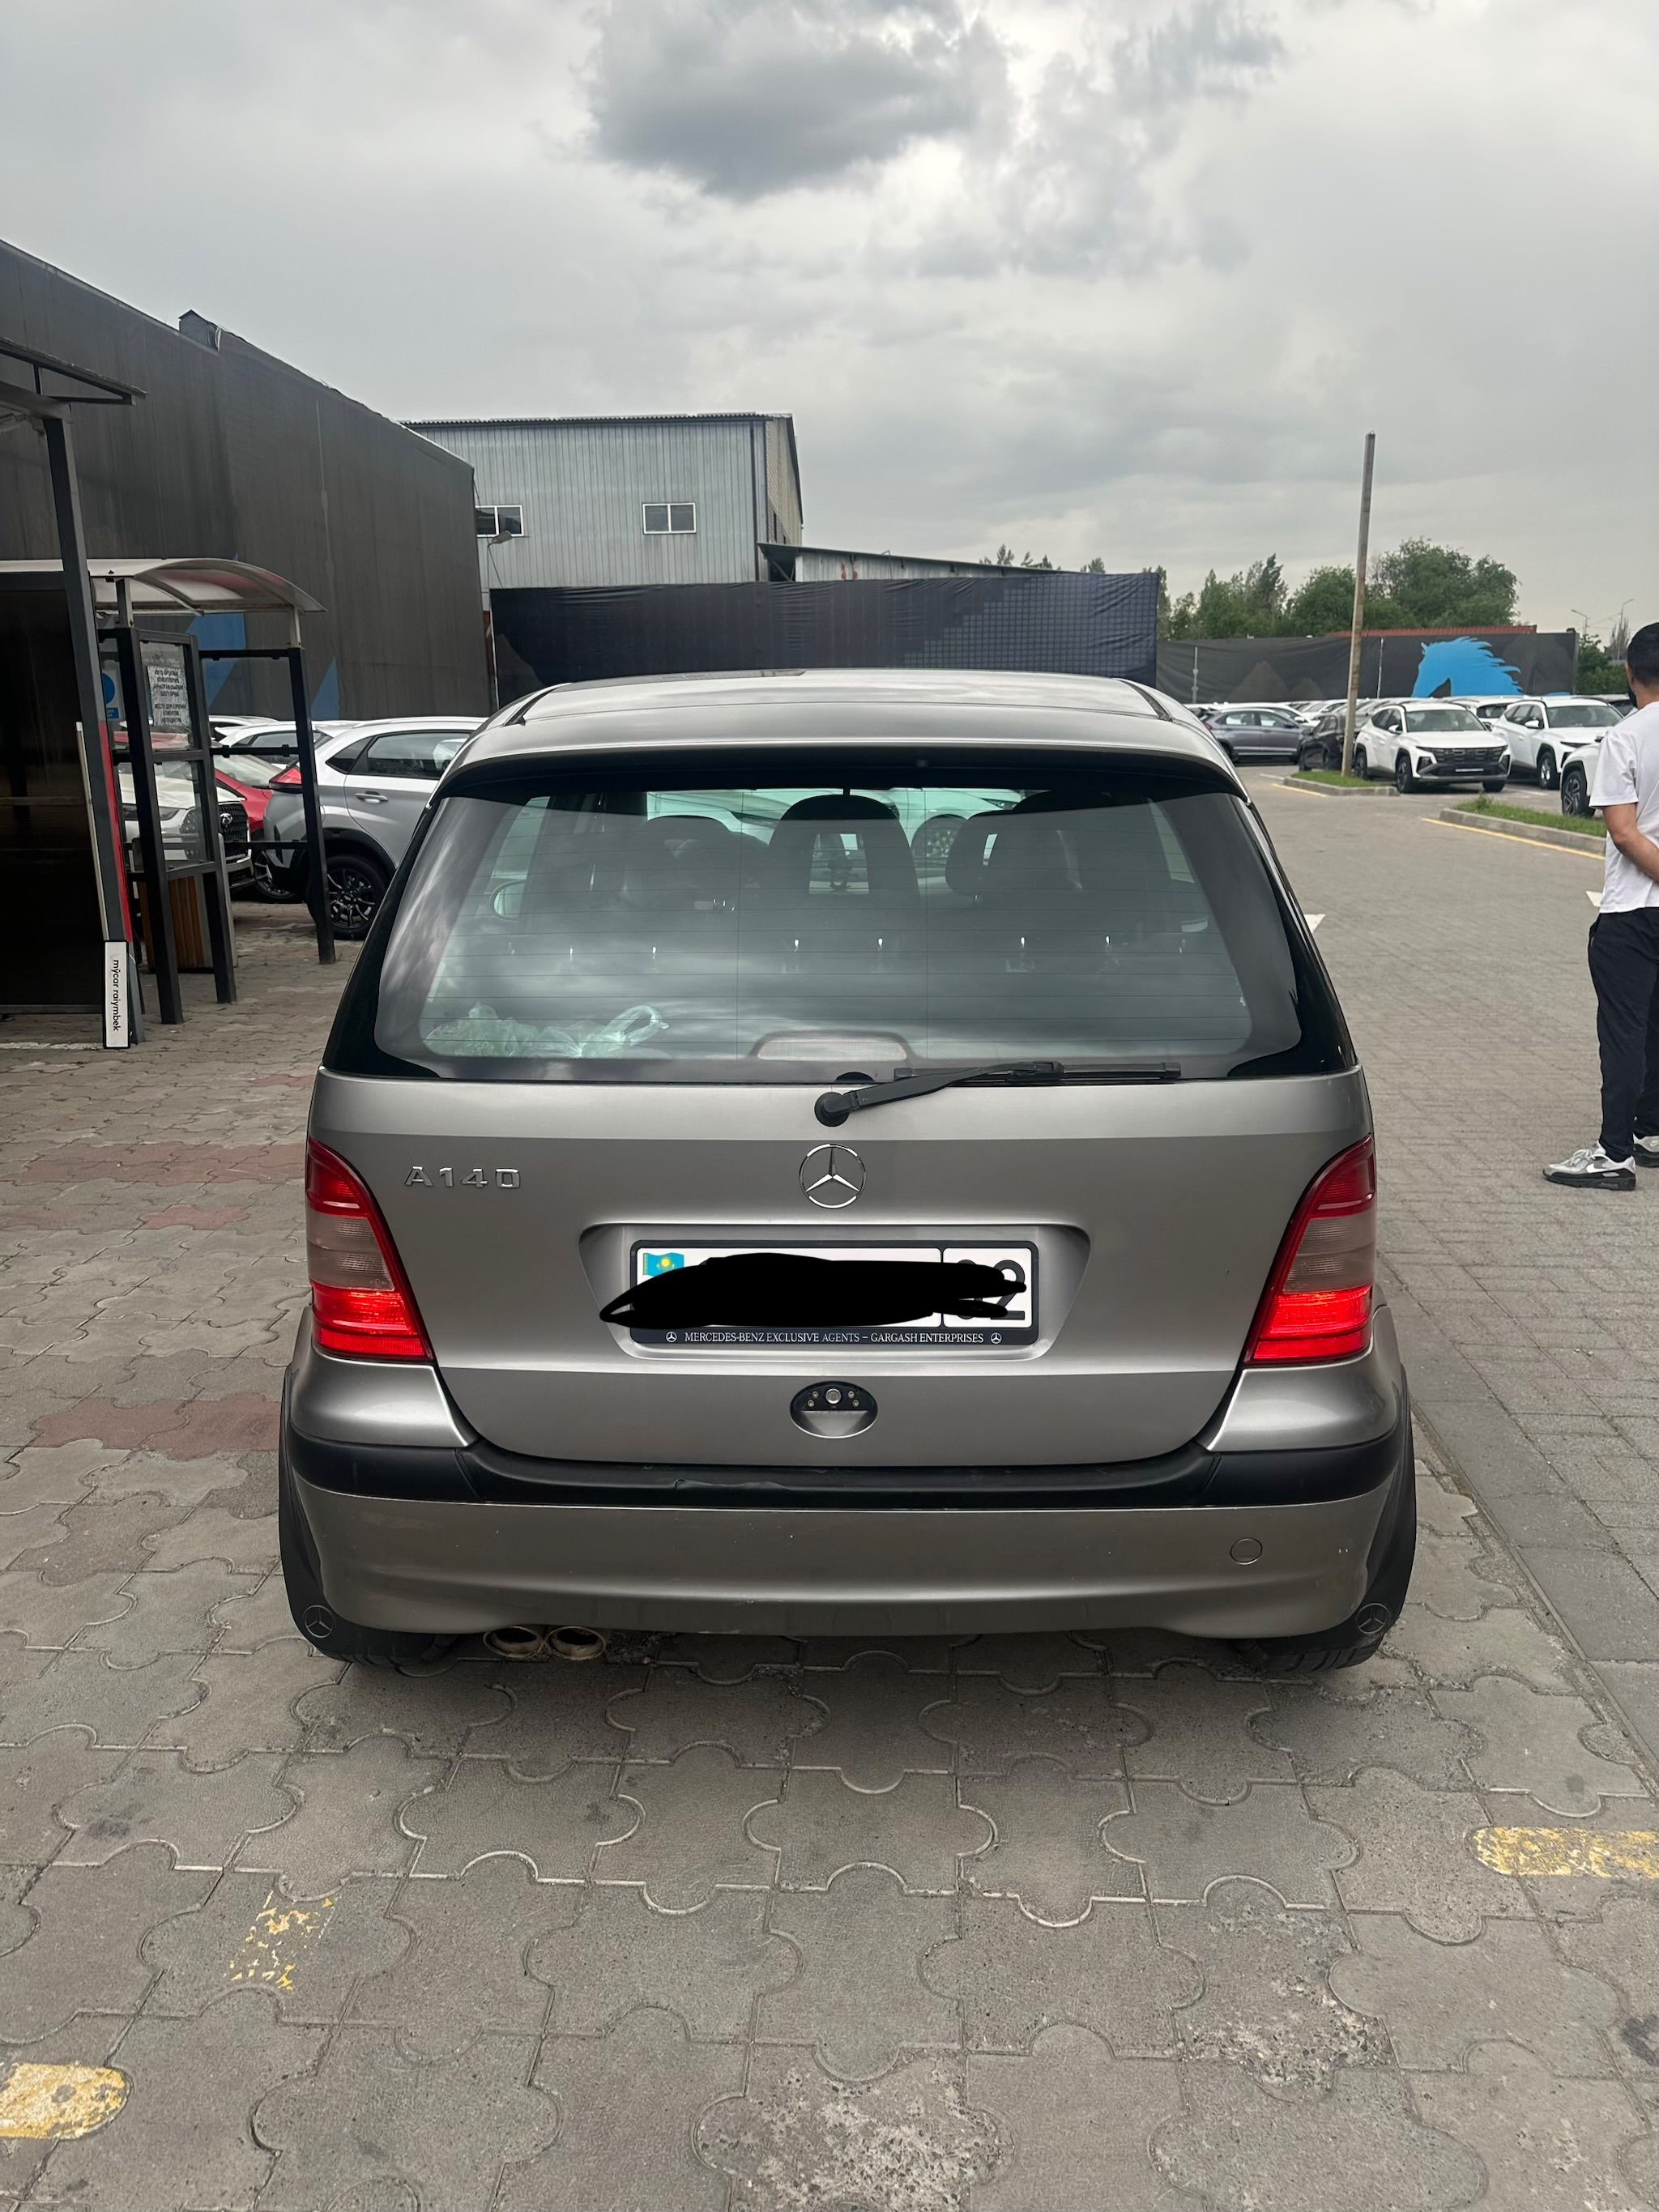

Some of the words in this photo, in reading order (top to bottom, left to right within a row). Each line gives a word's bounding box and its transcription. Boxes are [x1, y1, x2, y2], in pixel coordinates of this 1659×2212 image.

[111, 990, 121, 1030] raiymbek
[684, 1332, 764, 1342] MERCEDES-BENZ
[766, 1332, 819, 1342] EXCLUSIVE
[822, 1332, 859, 1342] AGENTS
[871, 1332, 917, 1342] GARGASH
[919, 1332, 984, 1342] ENTERPRISES
